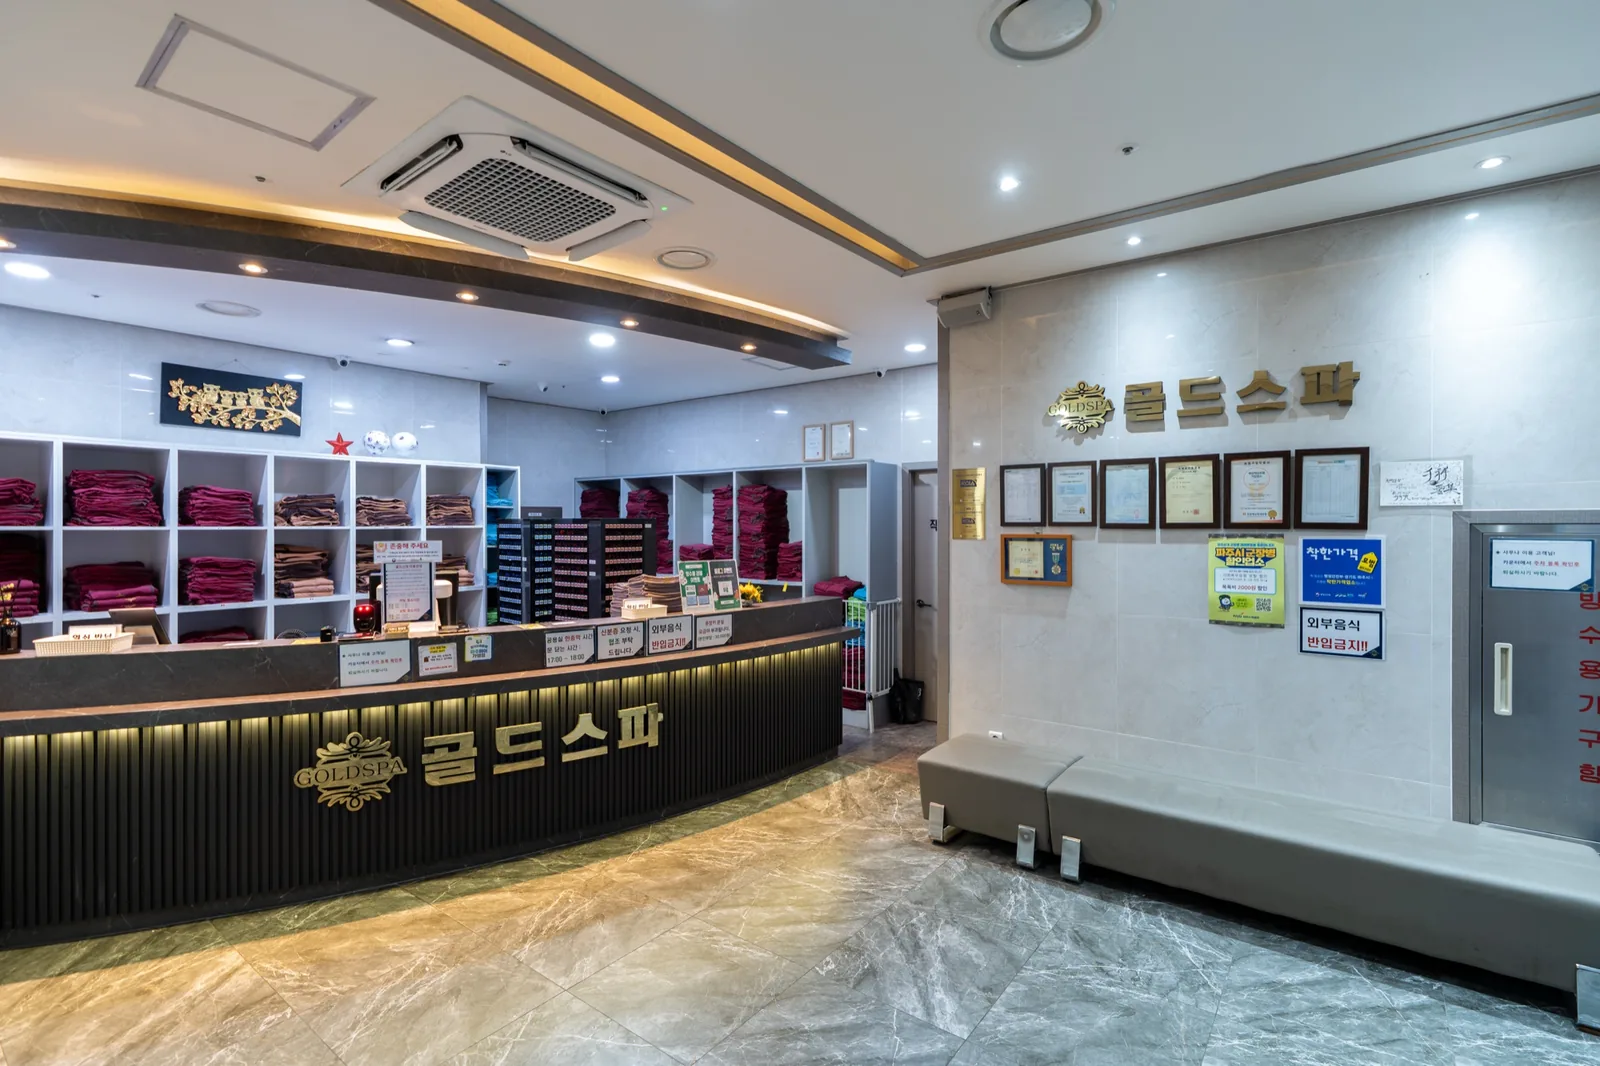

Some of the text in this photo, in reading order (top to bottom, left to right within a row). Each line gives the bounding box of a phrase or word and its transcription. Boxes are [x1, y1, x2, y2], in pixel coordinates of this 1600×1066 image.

[1124, 361, 1360, 422] 골드스파
[1048, 398, 1114, 416] GOLDSPA
[1306, 546, 1358, 561] 착한가격
[601, 628, 618, 637] 신분증
[620, 626, 632, 634] 요청
[652, 622, 682, 634] 외부음식
[1307, 617, 1360, 632] 외부음식
[608, 636, 634, 646] 협조 부탁
[652, 637, 686, 650] 반입금지!!
[1307, 636, 1368, 652] 반입금지!!
[548, 655, 563, 663] 17:00
[608, 647, 634, 656] 드립니다.
[422, 702, 664, 787] 골드스파
[295, 758, 406, 787] GOLDSPA
